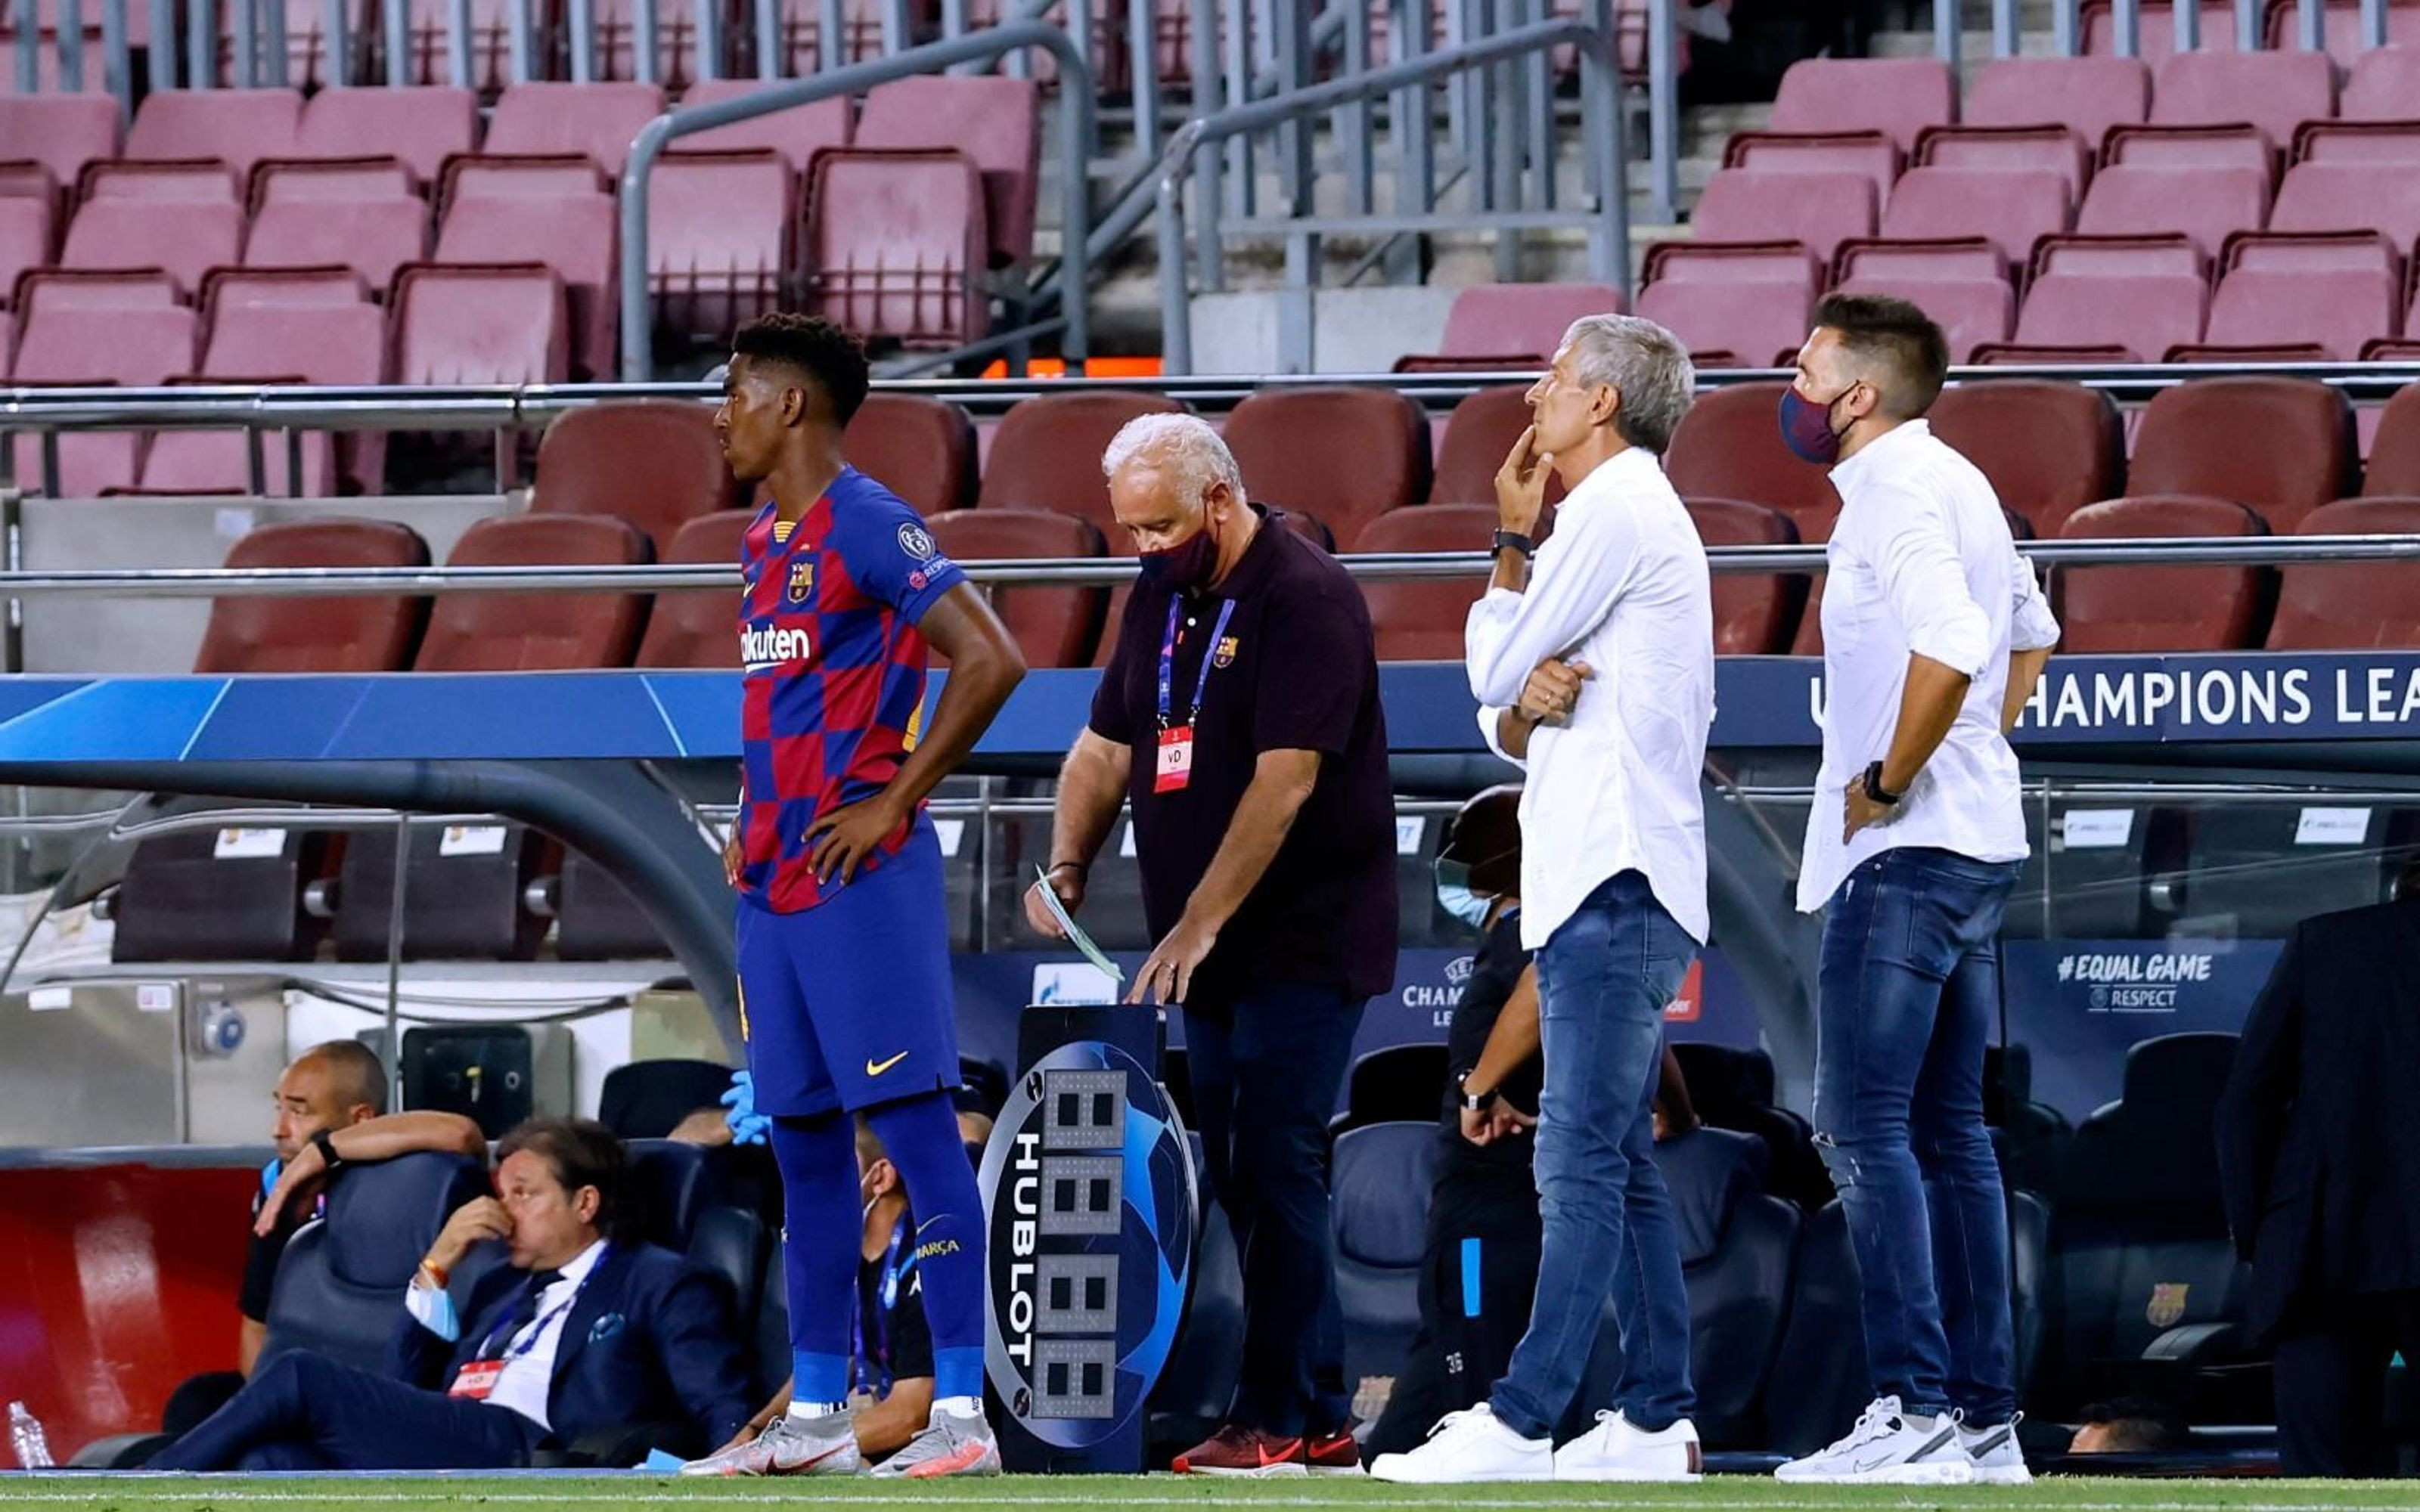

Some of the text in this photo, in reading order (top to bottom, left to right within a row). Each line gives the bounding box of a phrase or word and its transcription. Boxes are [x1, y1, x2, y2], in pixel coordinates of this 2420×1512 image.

[739, 622, 810, 662] akuten
[2014, 669, 2311, 727] HAMPIONS
[2058, 954, 2213, 981] #EQUAL GAME
[1403, 985, 1465, 1007] CHAM
[2111, 990, 2176, 1006] RESPECT
[1434, 1011, 1453, 1026] LE
[1008, 1133, 1039, 1367] HUBLOT
[1446, 1352, 1463, 1373] 36
